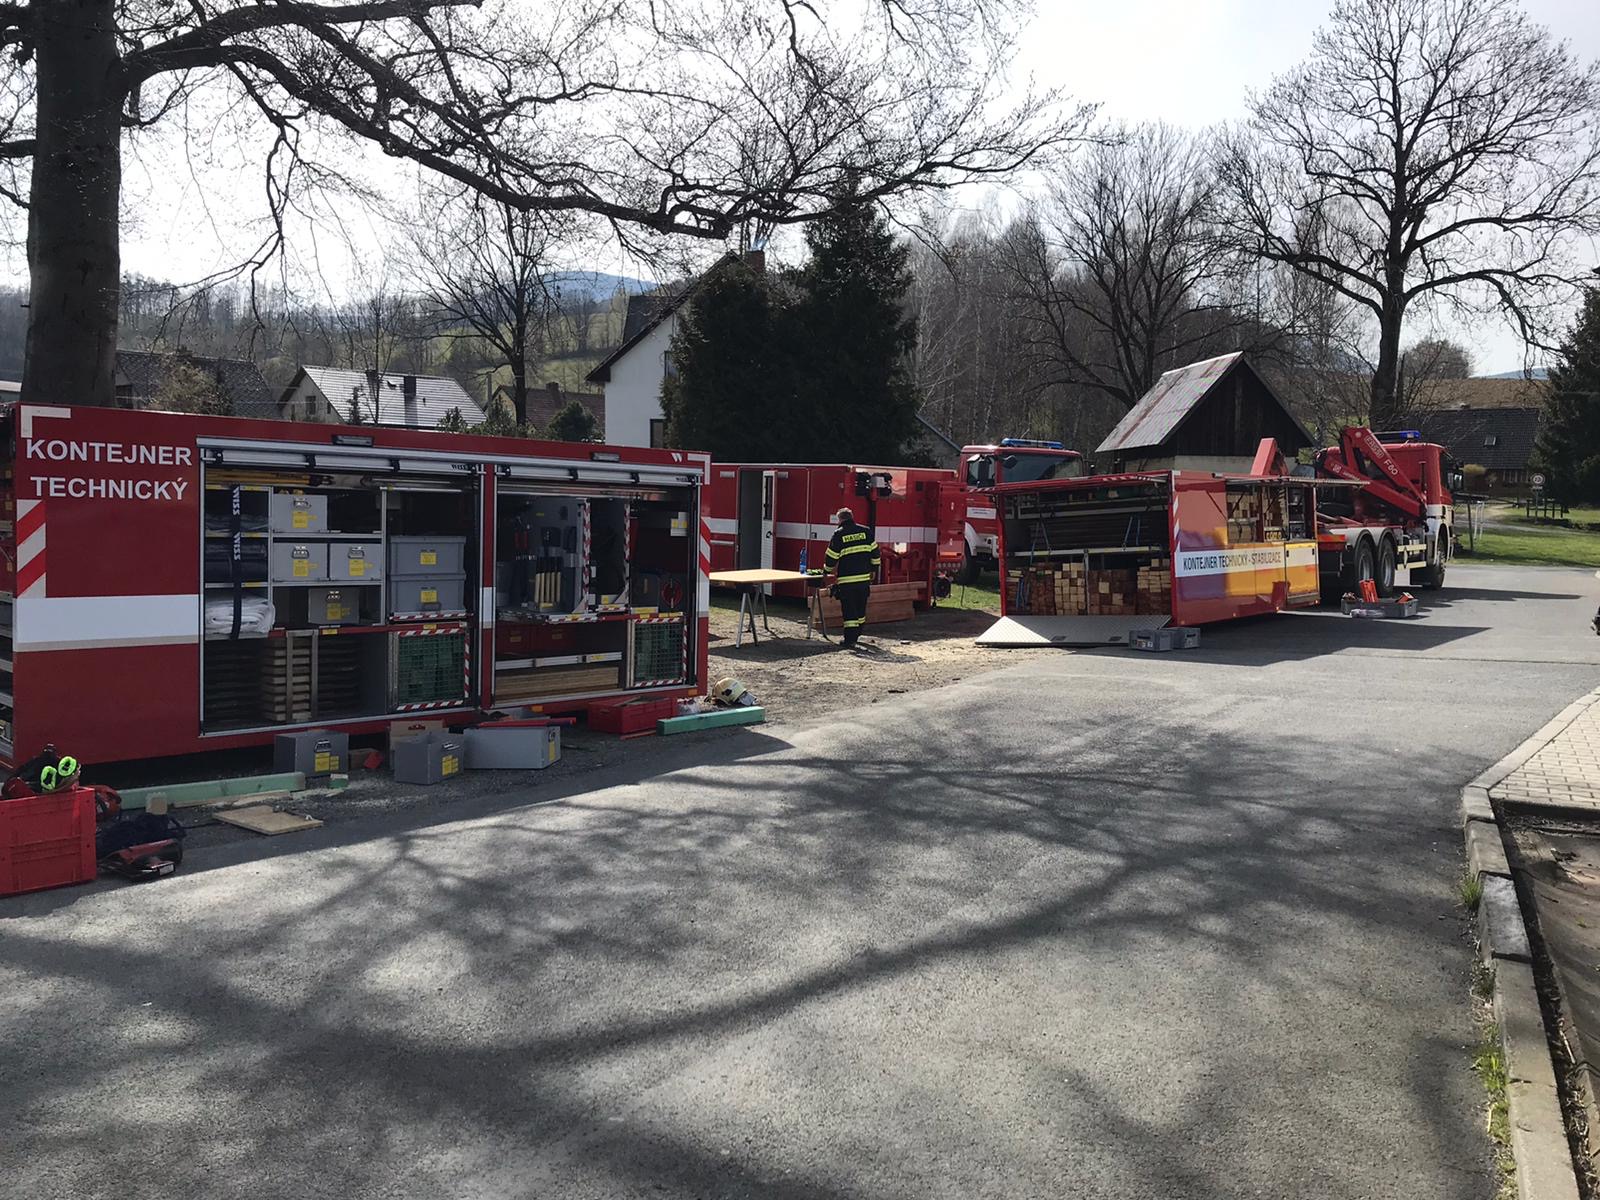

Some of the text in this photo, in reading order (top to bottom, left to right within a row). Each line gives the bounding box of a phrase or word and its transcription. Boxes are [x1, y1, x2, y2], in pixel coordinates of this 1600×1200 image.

[26, 438, 193, 466] KONTEJNER
[30, 476, 188, 501] TECHNICKÝ
[1183, 555, 1218, 571] KONTEJNER
